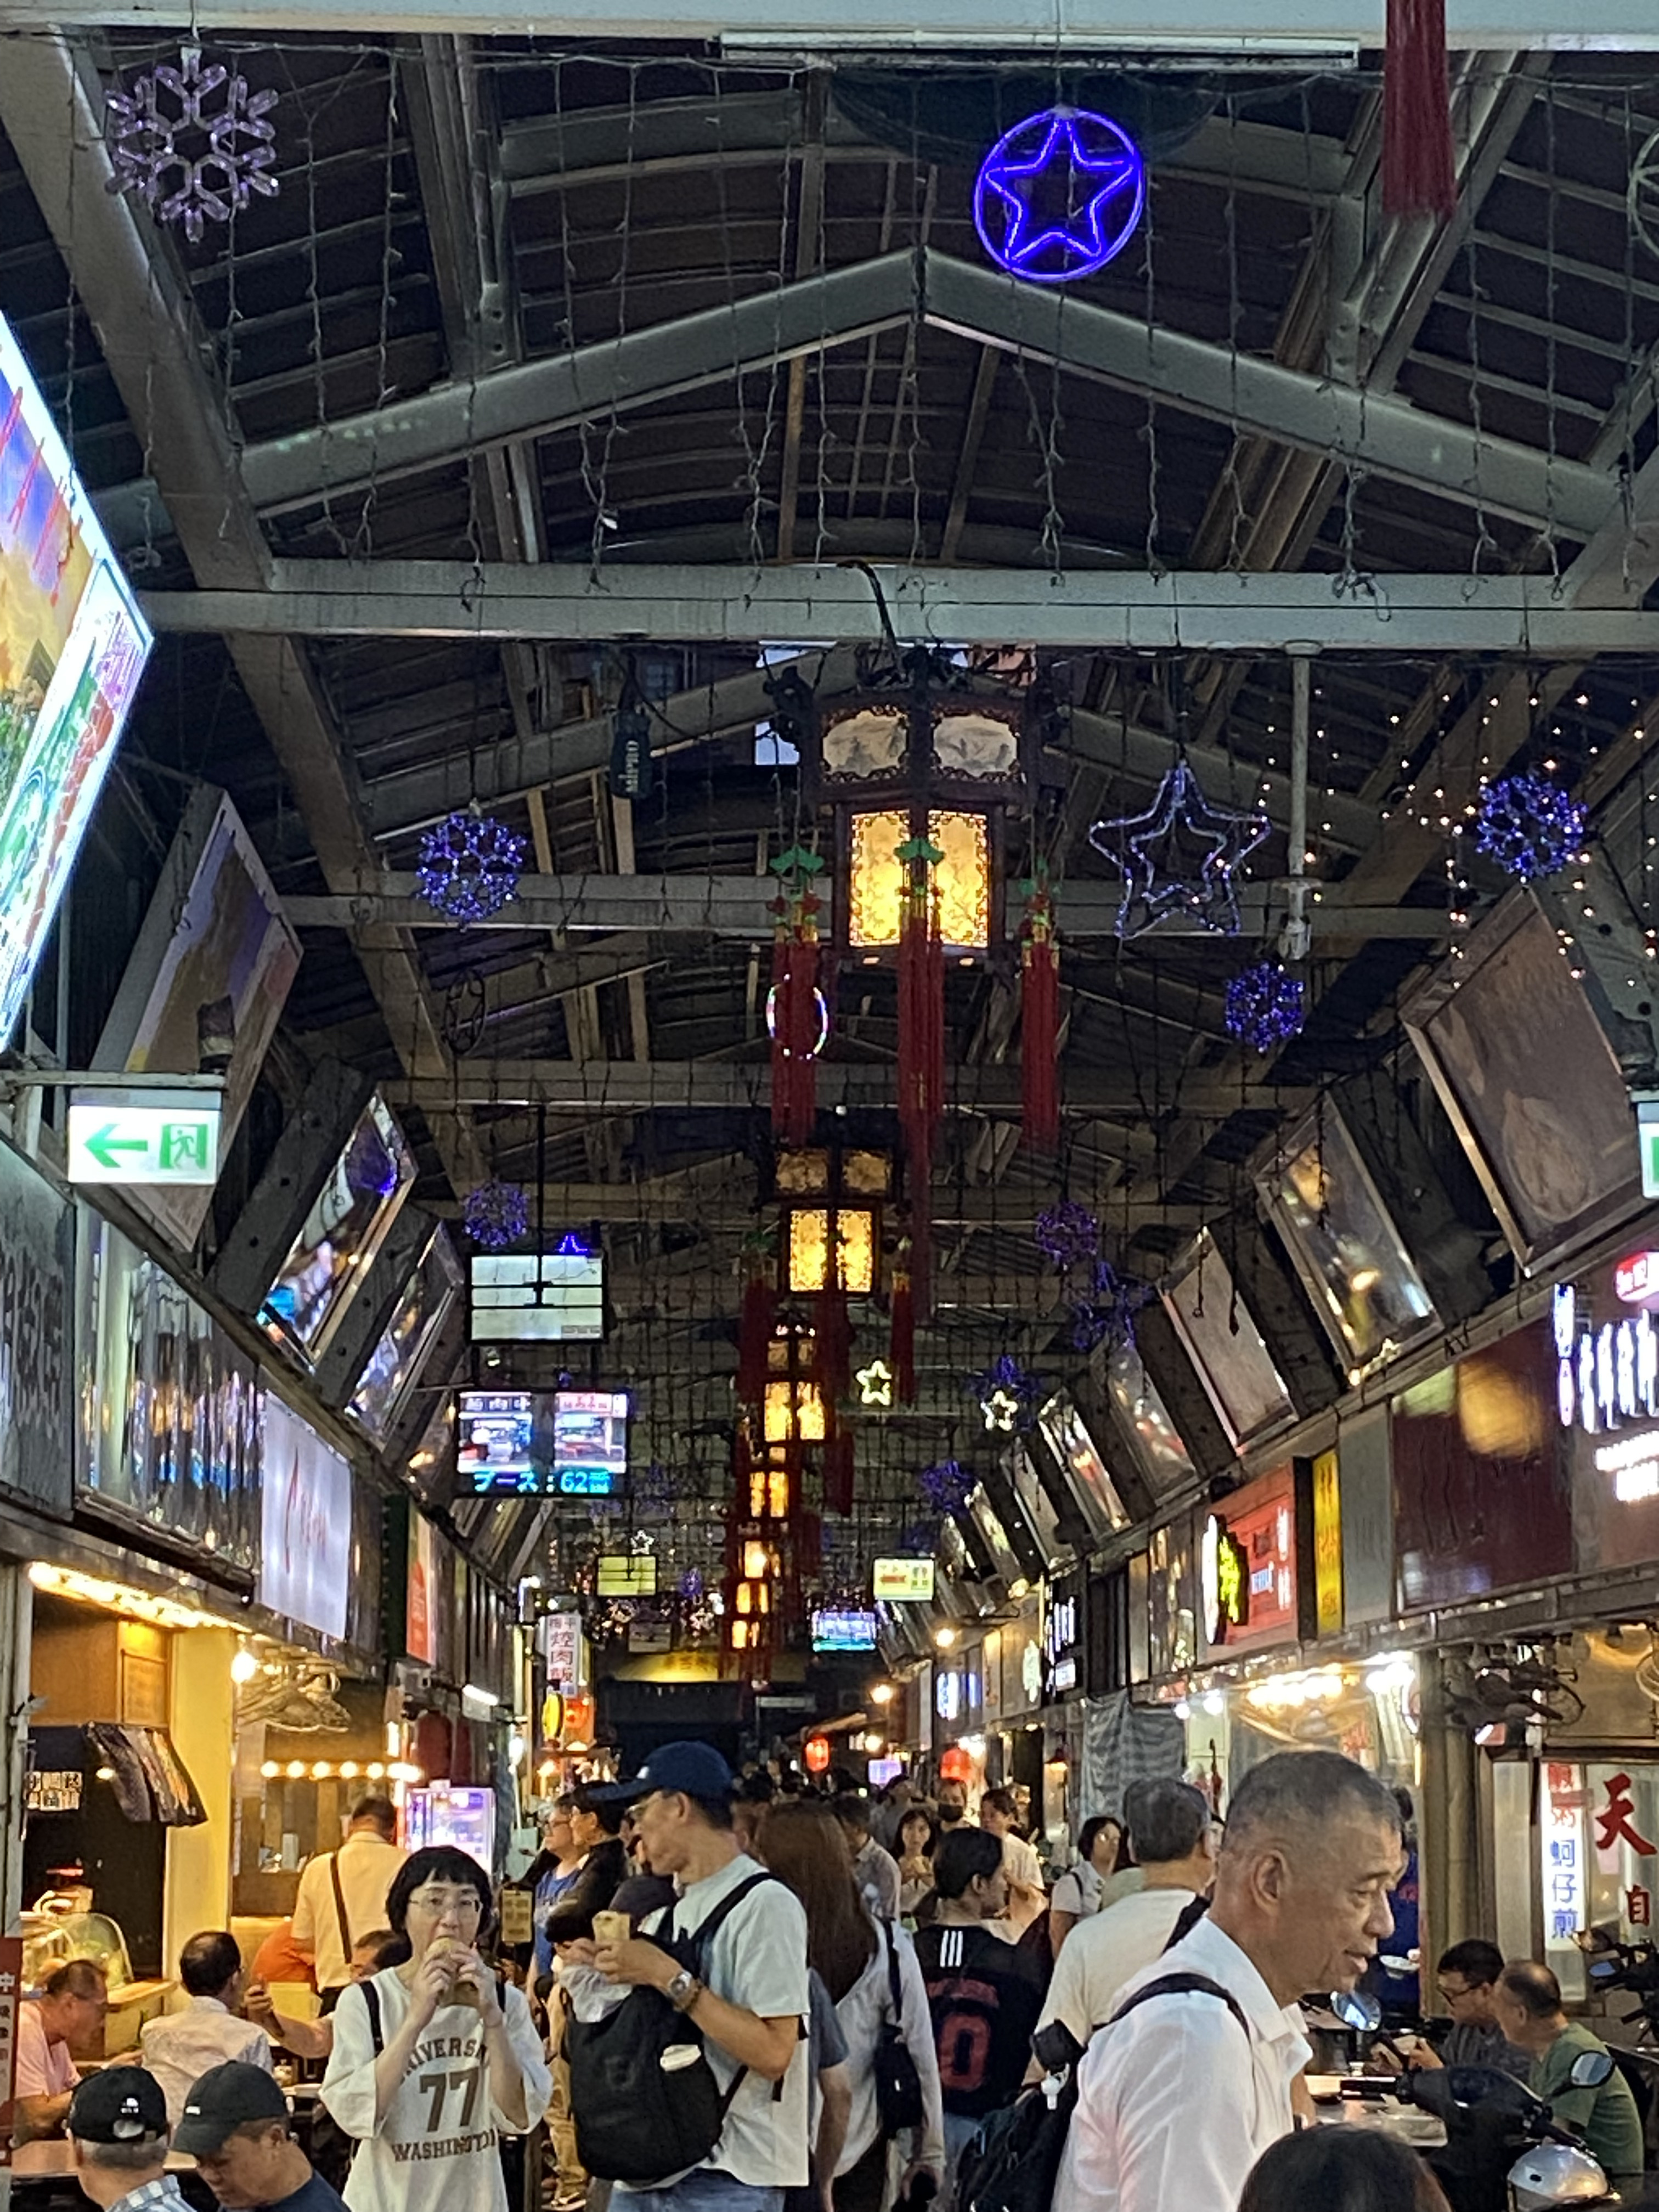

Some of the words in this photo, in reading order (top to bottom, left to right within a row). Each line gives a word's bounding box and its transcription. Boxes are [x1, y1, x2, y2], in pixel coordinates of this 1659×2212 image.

[1595, 1772, 1658, 1856] 天
[1626, 1884, 1650, 1927] 自
[419, 2067, 479, 2133] 77
